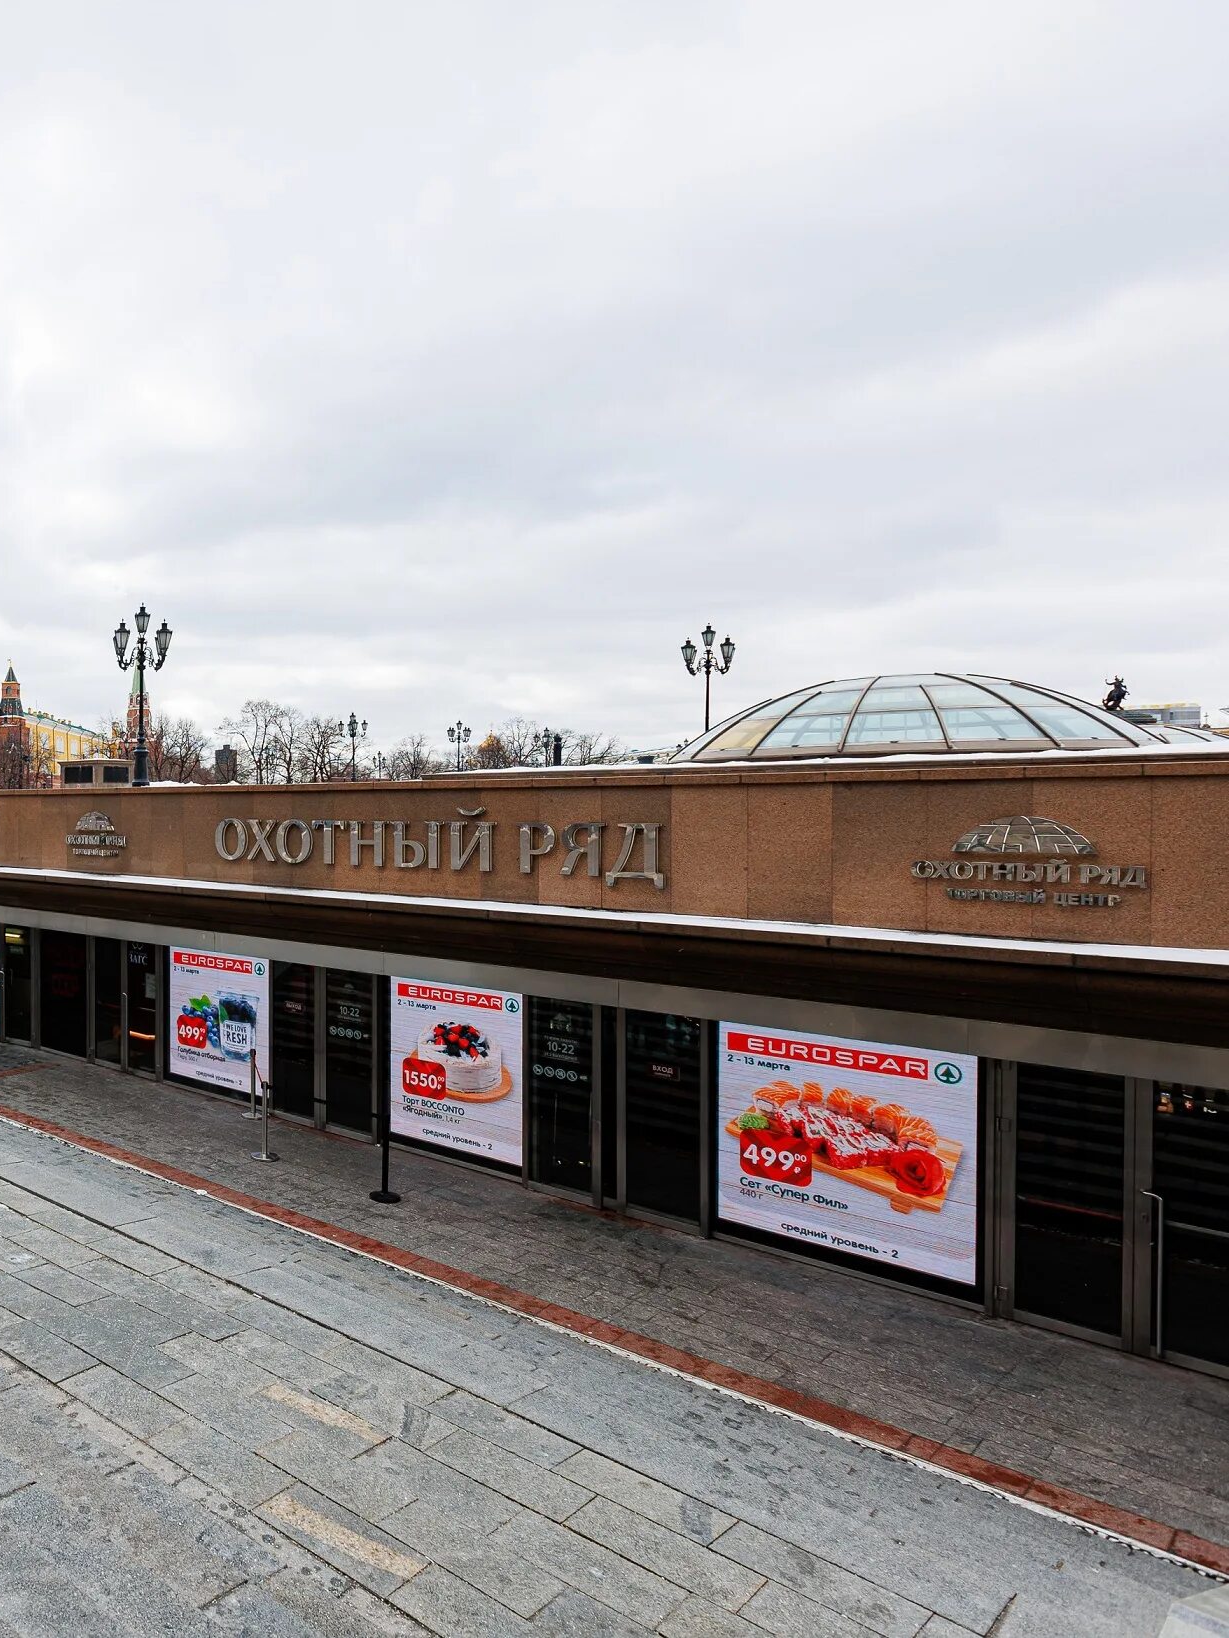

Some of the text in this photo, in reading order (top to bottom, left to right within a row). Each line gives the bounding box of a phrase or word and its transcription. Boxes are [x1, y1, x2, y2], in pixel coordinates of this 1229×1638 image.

[214, 806, 667, 891] ОХОТНЫЙ РЯД
[911, 859, 1149, 890] ОХОТНЫЙ РЯД
[946, 887, 1122, 907] ТОРГОВЫЙ ЦЕНТР
[181, 953, 253, 972] EUROSPAR
[408, 986, 502, 1009] EUROSPAR
[415, 1003, 436, 1011] марта
[178, 1024, 200, 1040] 499
[546, 1041, 575, 1055] 10-22
[747, 1037, 927, 1077] EUROSPAR
[652, 1064, 674, 1075] ВХОД
[727, 1054, 734, 1062] 2
[744, 1056, 755, 1065] 13
[757, 1060, 791, 1071] марта
[195, 1069, 214, 1079] средний
[215, 1074, 235, 1084] уровень
[404, 1069, 438, 1090] 1550
[402, 1095, 465, 1116] Торт BOCCONTO
[422, 1127, 451, 1141] средний
[451, 1135, 481, 1149] уровень
[742, 1143, 795, 1171] 499
[739, 1187, 757, 1198] 440
[740, 1176, 849, 1211] Сет «Супер Фил»
[780, 1221, 828, 1241] средний
[830, 1234, 879, 1256] уровень
[891, 1248, 899, 1259] 2
